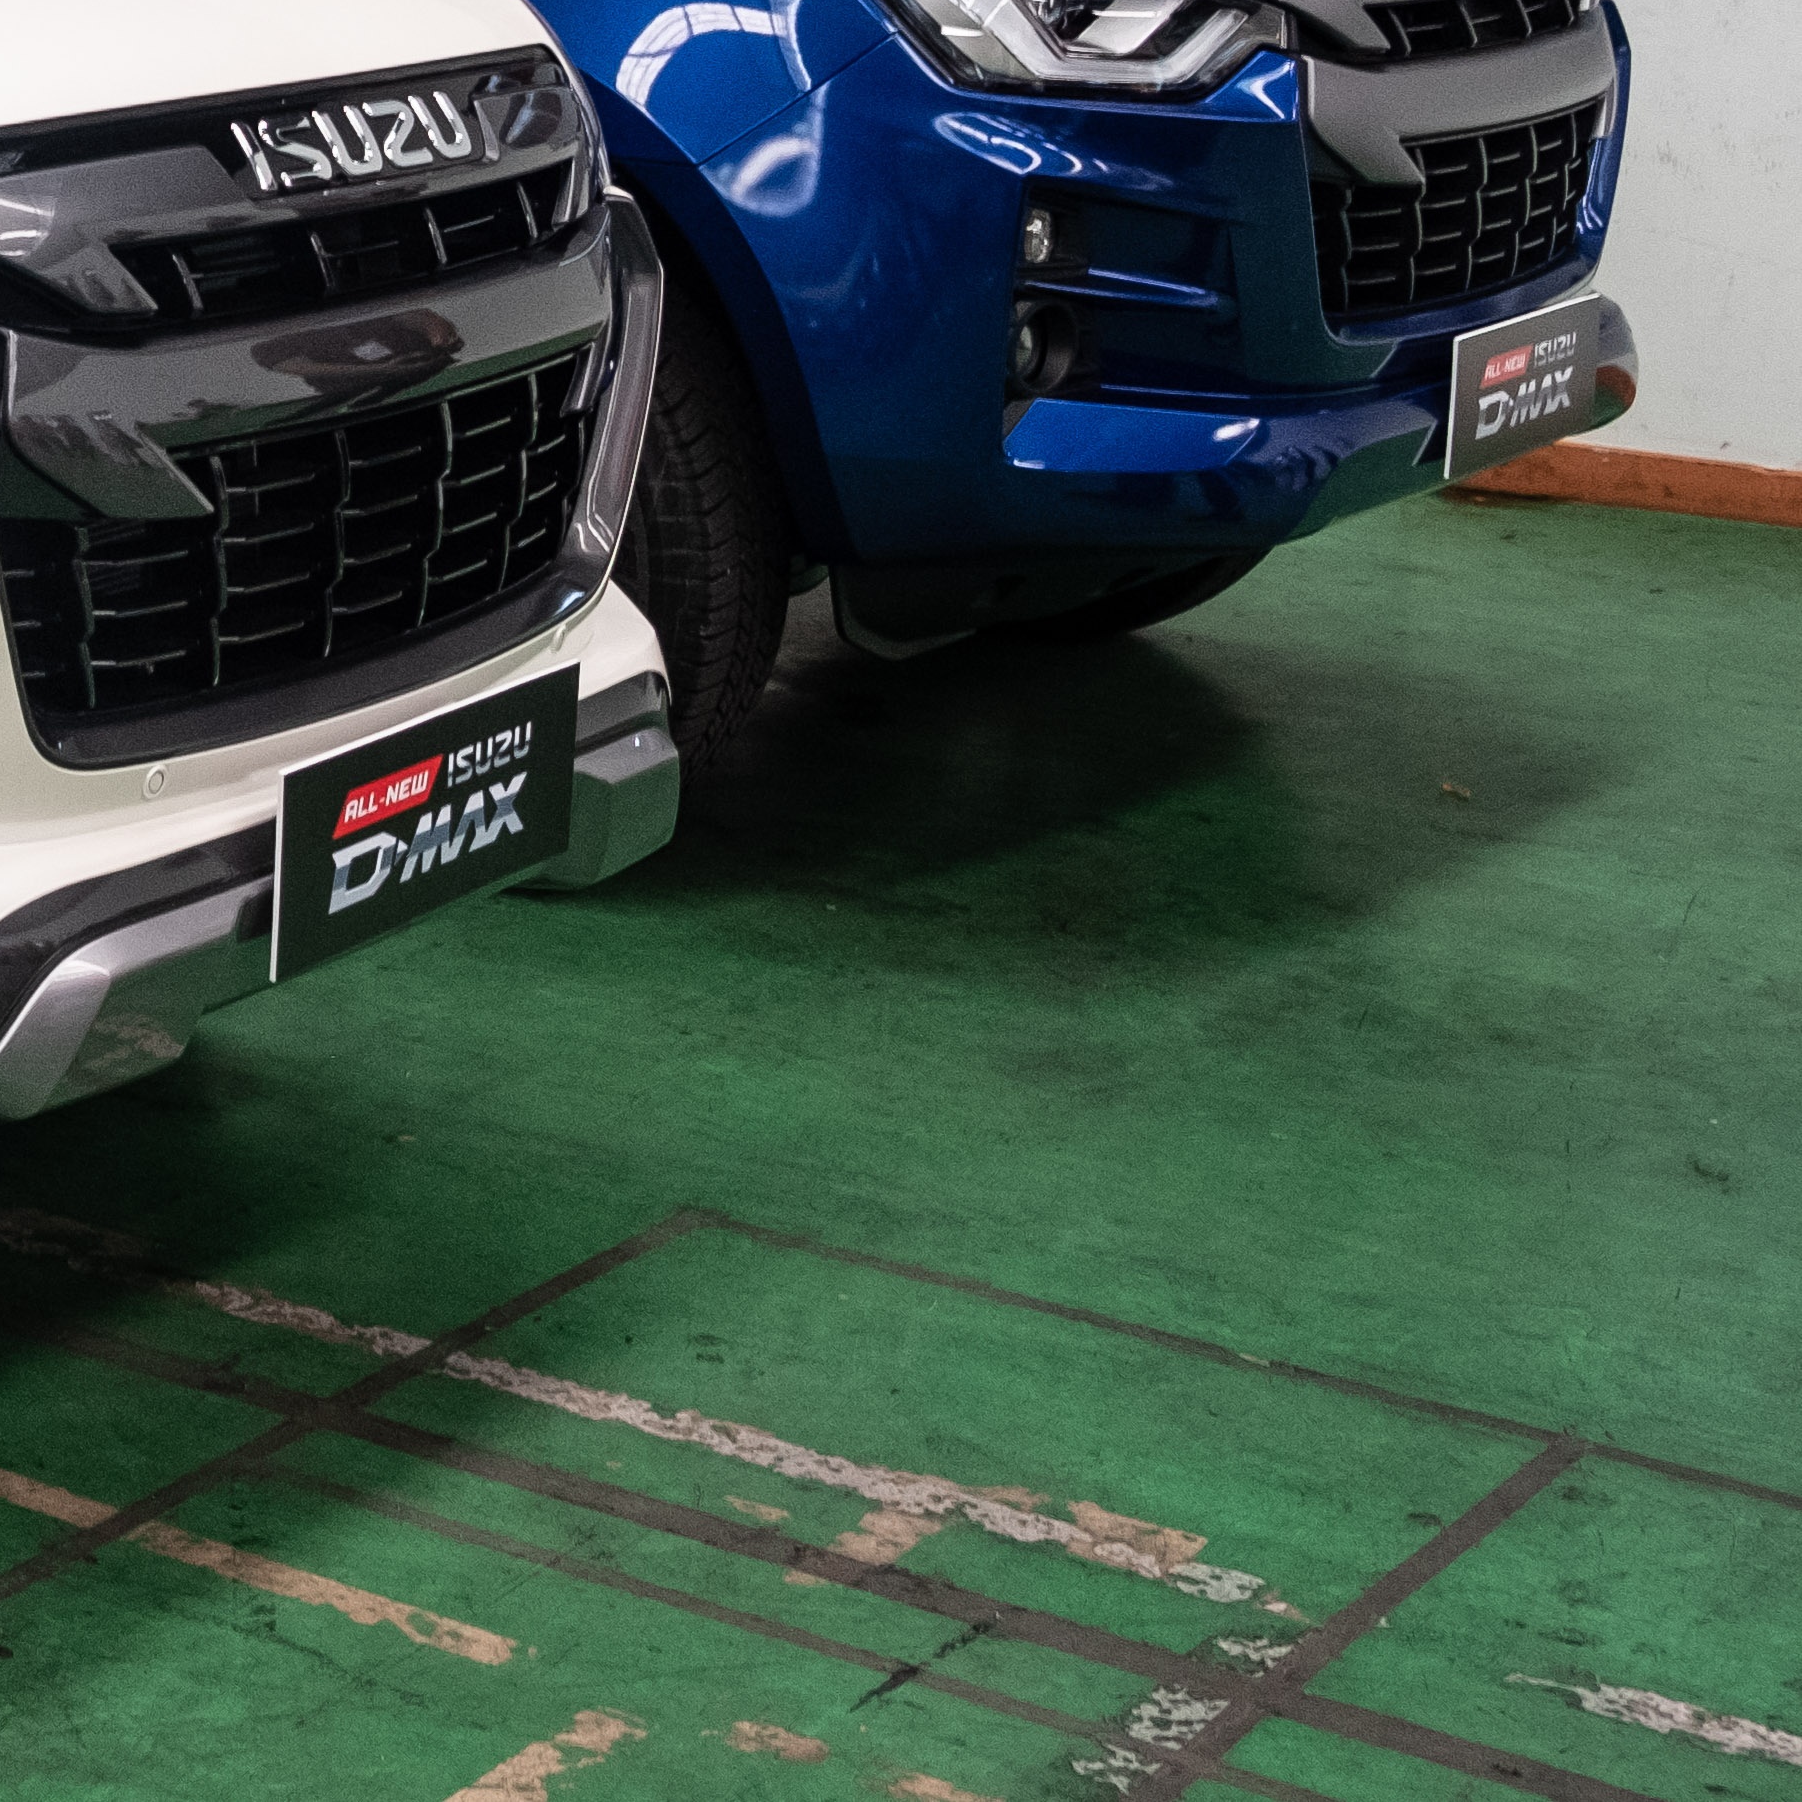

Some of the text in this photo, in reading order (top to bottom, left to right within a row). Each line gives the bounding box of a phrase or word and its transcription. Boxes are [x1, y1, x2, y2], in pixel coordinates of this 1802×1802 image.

[231, 91, 472, 191] ISUZU
[1534, 332, 1576, 366] ISUZU
[344, 721, 532, 823] ALL-NEW ISUZU
[328, 771, 527, 915] D-MAX
